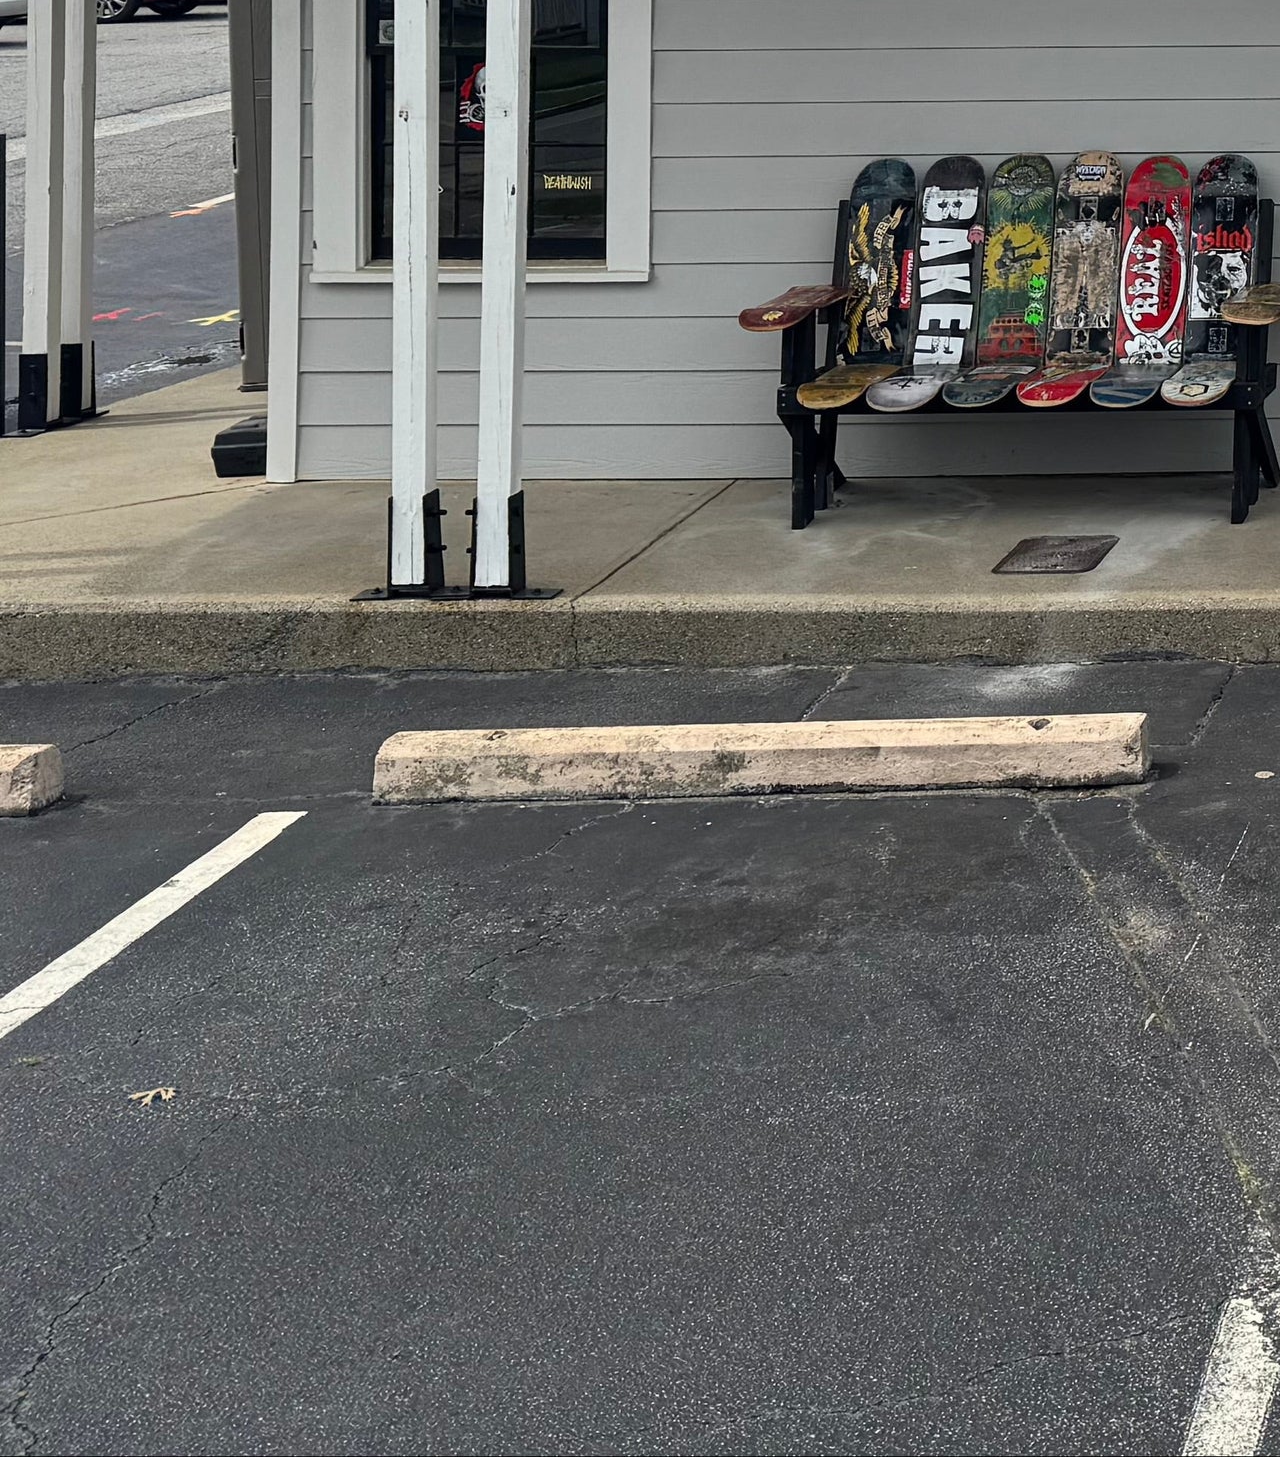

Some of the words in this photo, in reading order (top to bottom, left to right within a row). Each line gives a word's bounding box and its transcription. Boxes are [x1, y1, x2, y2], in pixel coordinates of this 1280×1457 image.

[543, 174, 592, 190] DEATHWISH
[913, 185, 979, 366] BAKER
[1128, 239, 1163, 322] REAL
